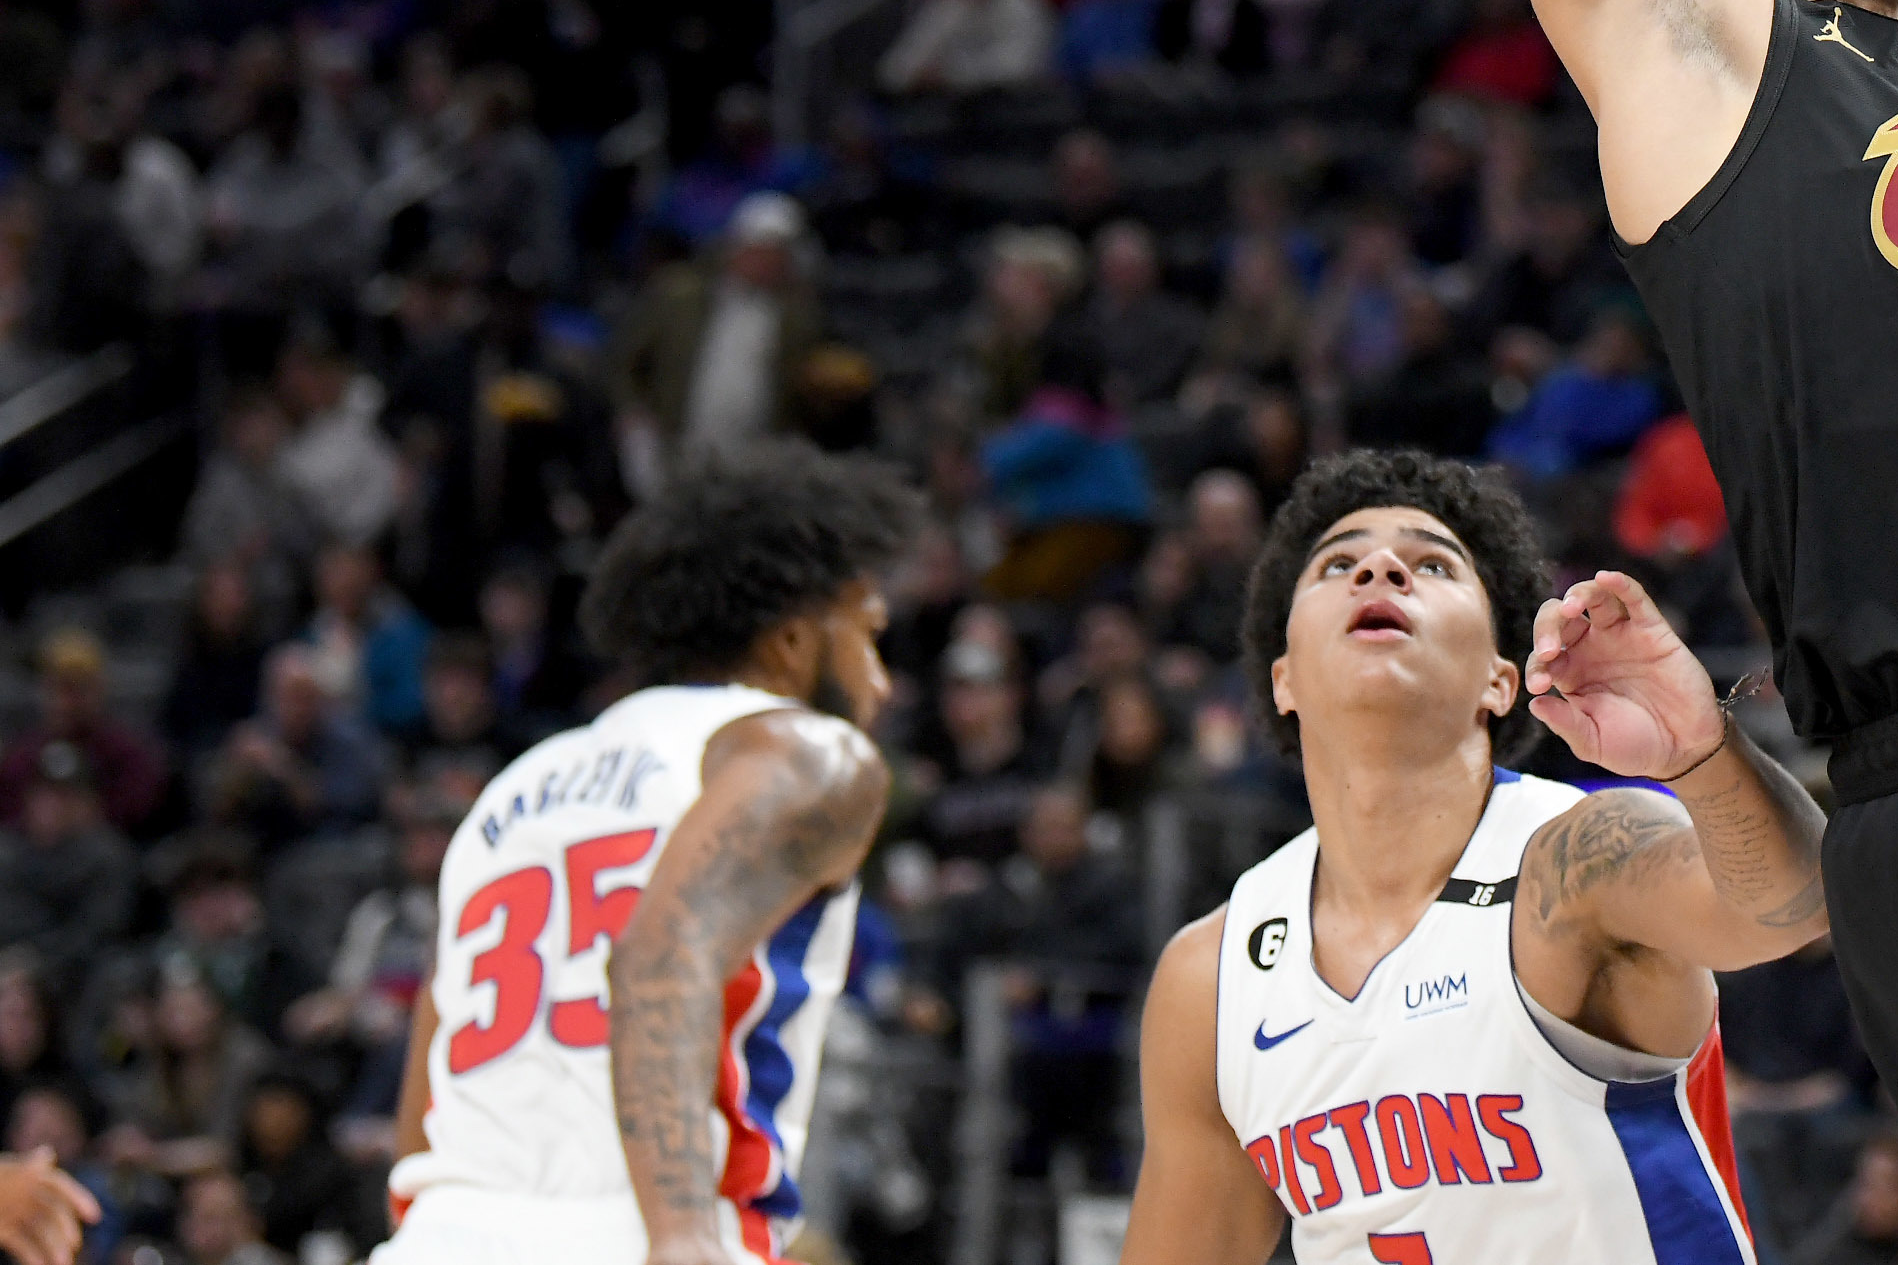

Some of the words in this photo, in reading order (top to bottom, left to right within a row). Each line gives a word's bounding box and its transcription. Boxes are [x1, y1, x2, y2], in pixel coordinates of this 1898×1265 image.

[1469, 885, 1495, 906] 16
[449, 827, 656, 1076] 35
[1258, 923, 1286, 966] 6
[1406, 972, 1468, 1008] UWM
[1246, 1093, 1542, 1215] PISTONS
